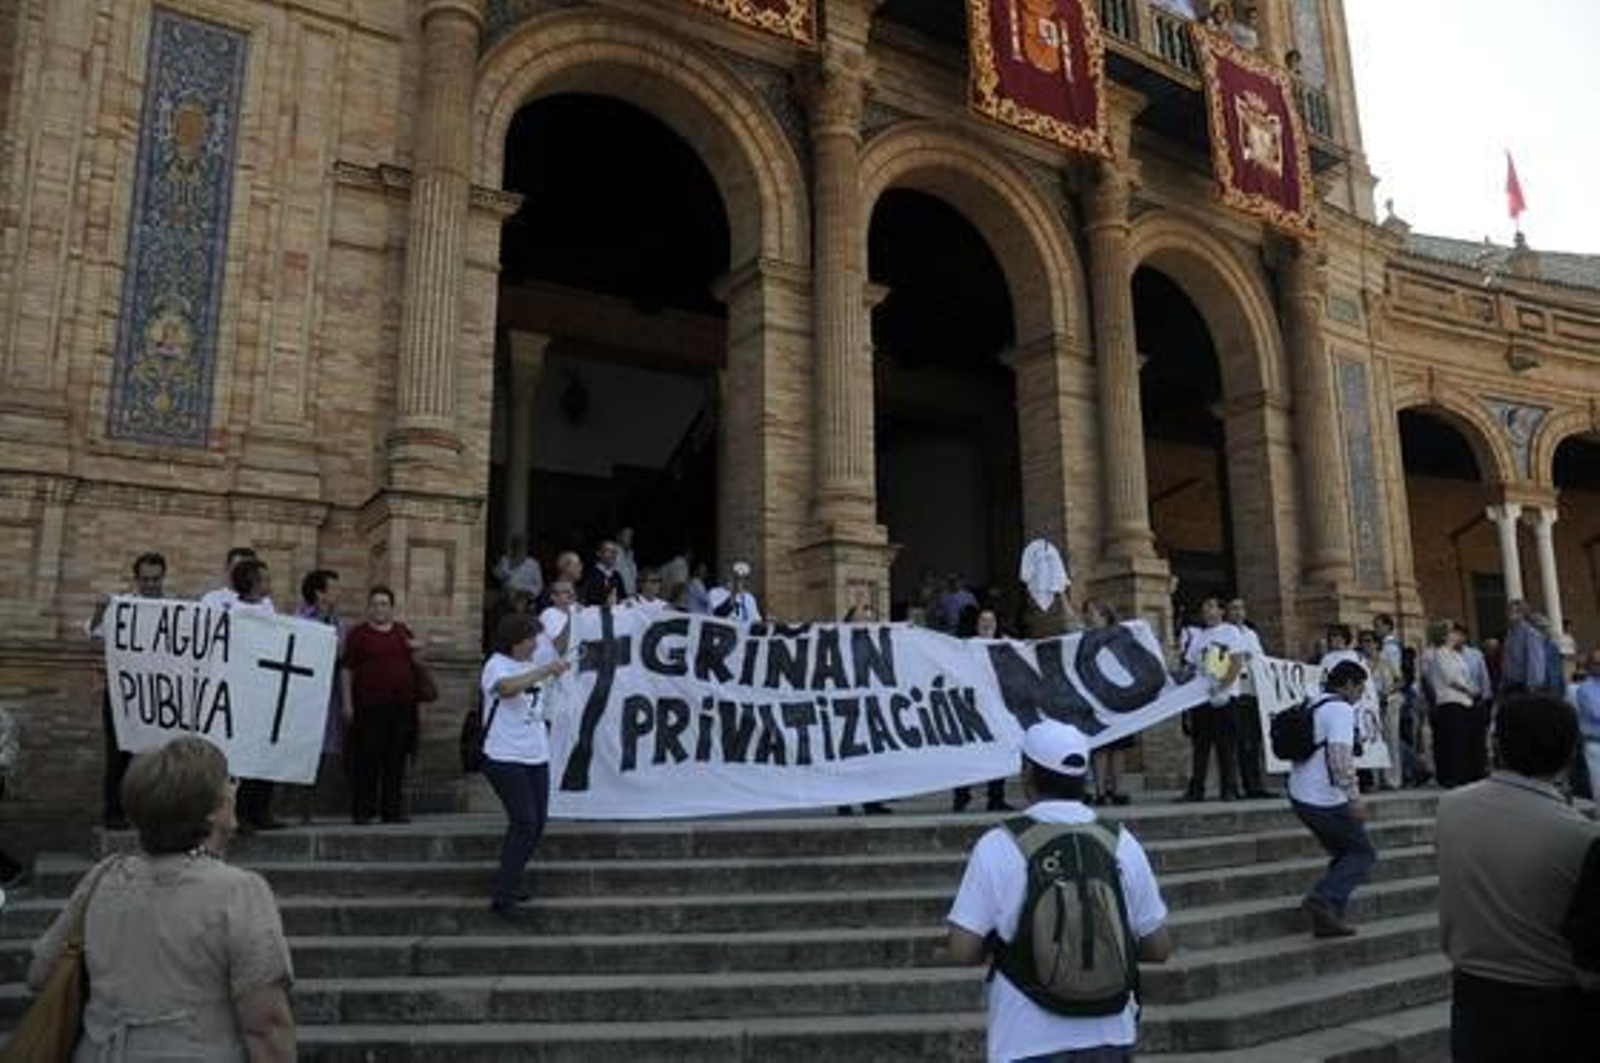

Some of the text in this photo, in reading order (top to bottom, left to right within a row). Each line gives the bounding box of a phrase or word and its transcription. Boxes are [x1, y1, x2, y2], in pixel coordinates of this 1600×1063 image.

[115, 602, 230, 663] EL AGUA
[987, 624, 1168, 737] NO
